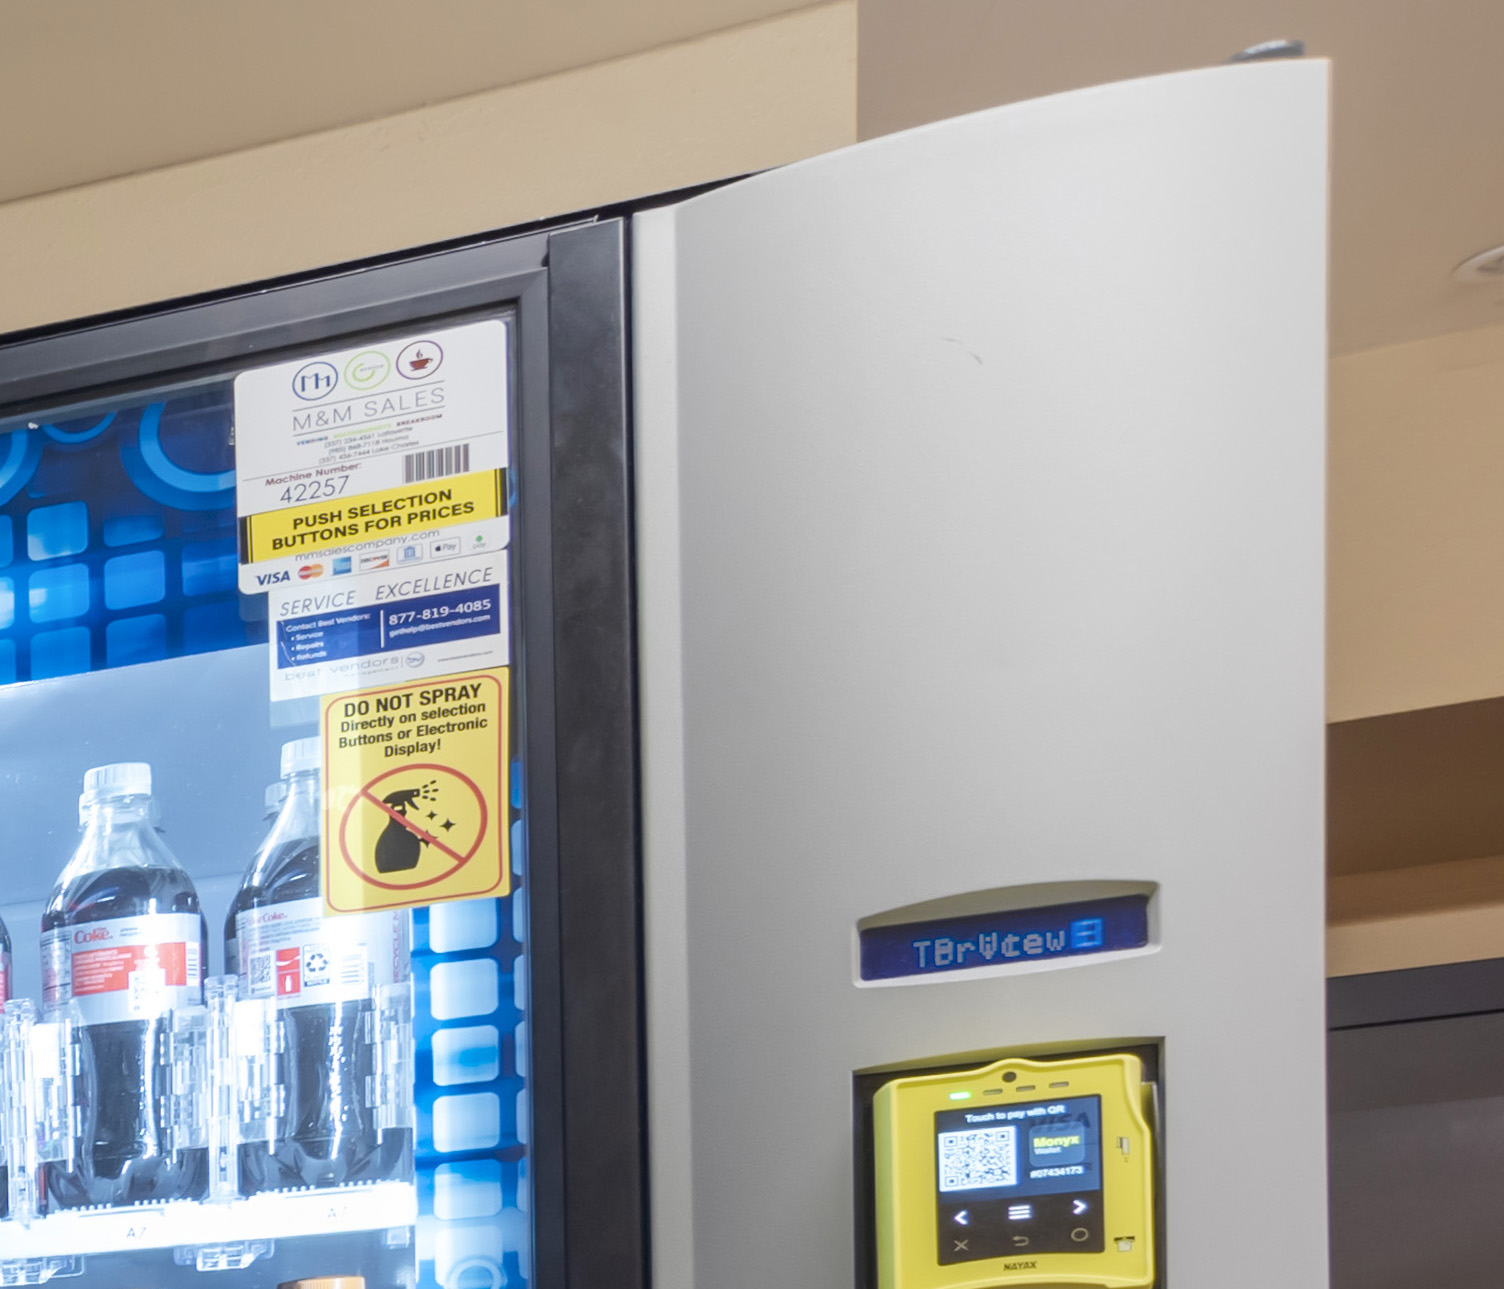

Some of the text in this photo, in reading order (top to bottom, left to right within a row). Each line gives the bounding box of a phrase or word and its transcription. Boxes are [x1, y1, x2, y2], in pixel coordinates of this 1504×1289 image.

[292, 387, 446, 431] M&M SALES
[265, 461, 363, 487] Machine Number:
[280, 475, 350, 503] 42257
[292, 488, 453, 530] PUSH SELECTION
[271, 501, 475, 550] BUTTONS FOR PRICES
[294, 529, 440, 562] mmsalescompany.com
[255, 570, 291, 586] VISA
[280, 567, 494, 616] SERVICE EXCELLENCE
[286, 621, 317, 633] Contact
[318, 617, 335, 628] Best
[388, 599, 491, 626] 877-819-4085
[344, 683, 482, 718] DO NOT SPRAY
[341, 701, 486, 733] Directly on selection
[338, 717, 488, 749] Buttons or Electronic
[384, 738, 442, 759] Display!
[965, 1104, 1067, 1124] Touch to pay with QR
[1033, 1135, 1080, 1148] Monyx
[1003, 1260, 1038, 1271] NAYAX
